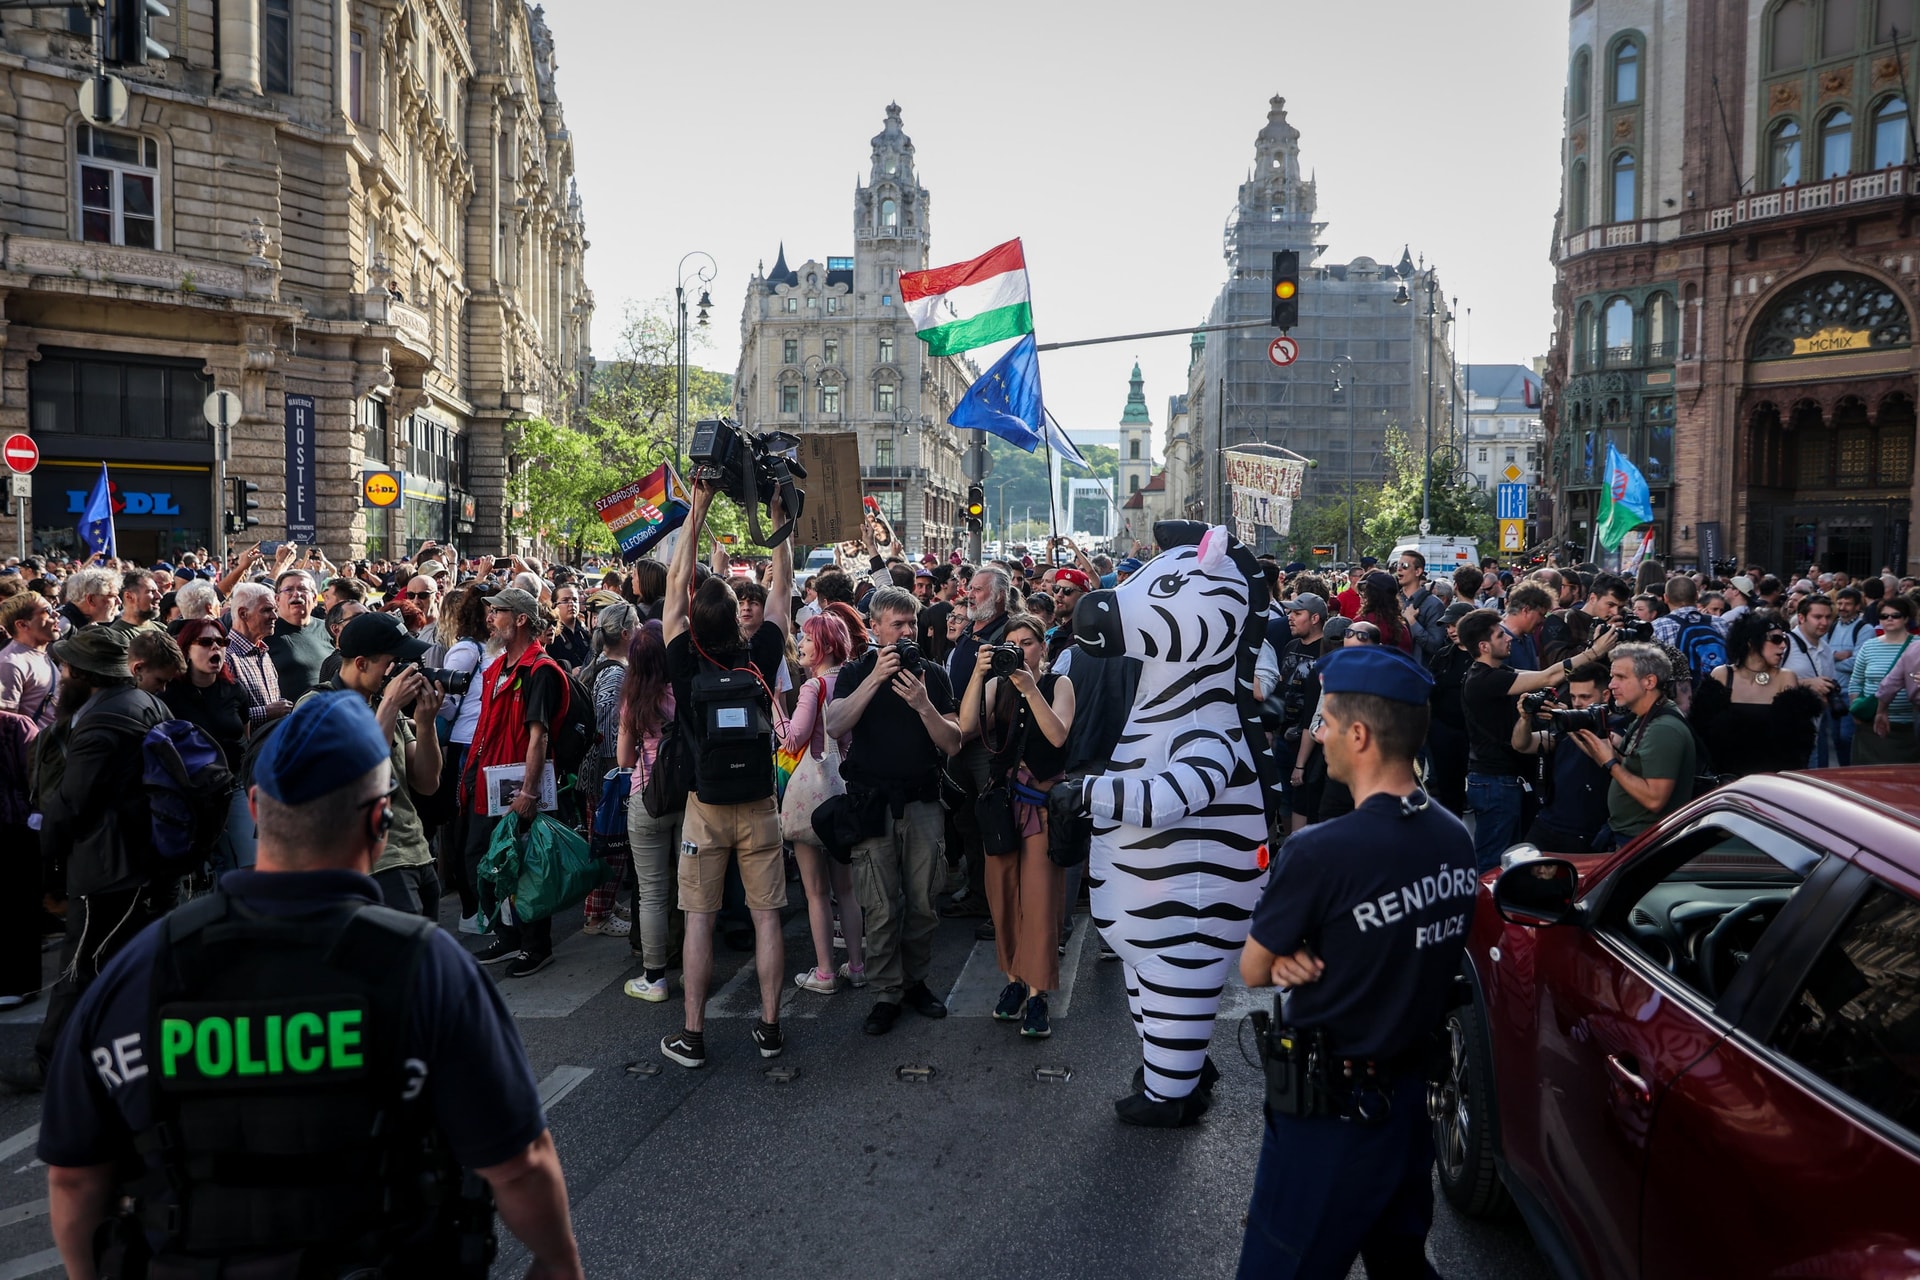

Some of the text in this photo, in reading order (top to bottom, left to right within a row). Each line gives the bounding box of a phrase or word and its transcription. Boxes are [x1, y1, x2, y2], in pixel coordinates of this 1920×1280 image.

[1809, 335, 1853, 351] MCMIX
[288, 398, 313, 409] MAVERICK
[296, 408, 306, 522] HOSTEL
[368, 483, 396, 494] LIDL
[608, 509, 640, 531] SZERETET
[1352, 863, 1477, 932] RENDŐRS
[1415, 913, 1465, 949] POLICE
[161, 1009, 364, 1078] POLICE
